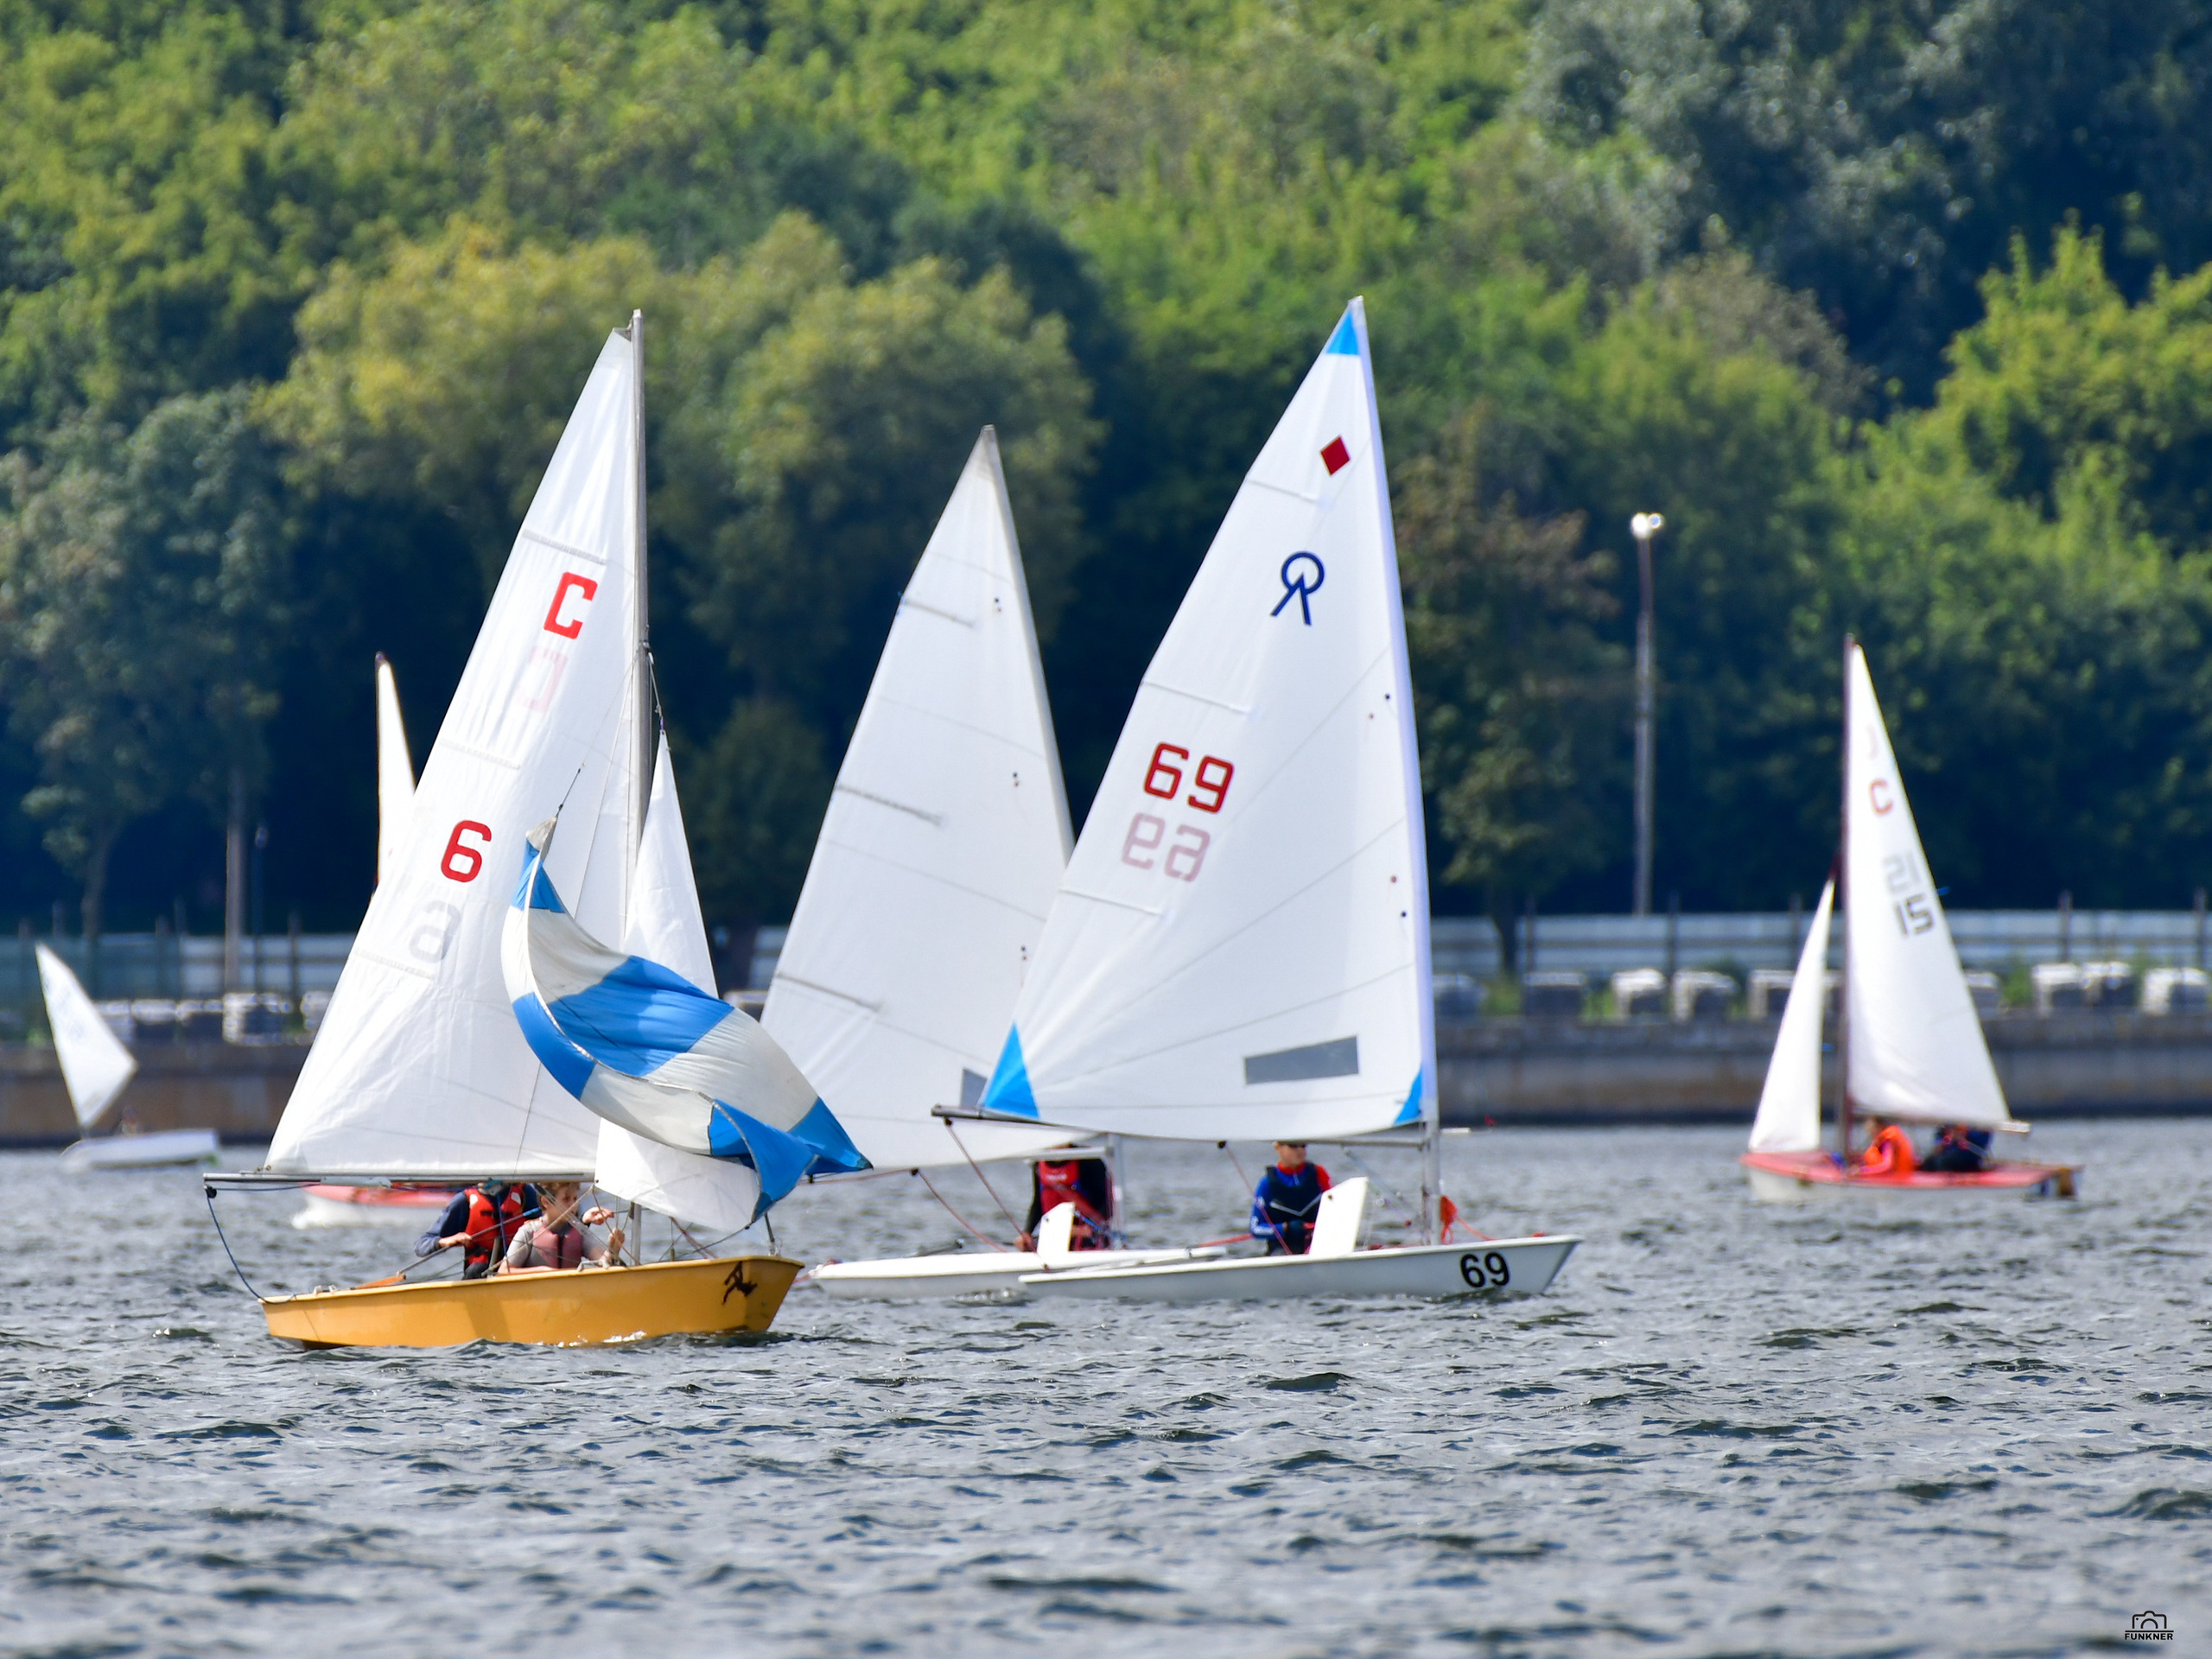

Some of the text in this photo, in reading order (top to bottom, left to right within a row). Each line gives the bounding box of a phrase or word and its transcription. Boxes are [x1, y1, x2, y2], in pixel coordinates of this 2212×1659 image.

[543, 571, 598, 639] C
[1143, 741, 1235, 814] 69
[1869, 779, 1893, 815] C
[440, 819, 492, 883] 6
[1893, 893, 1936, 938] 15
[1460, 1252, 1510, 1288] 69
